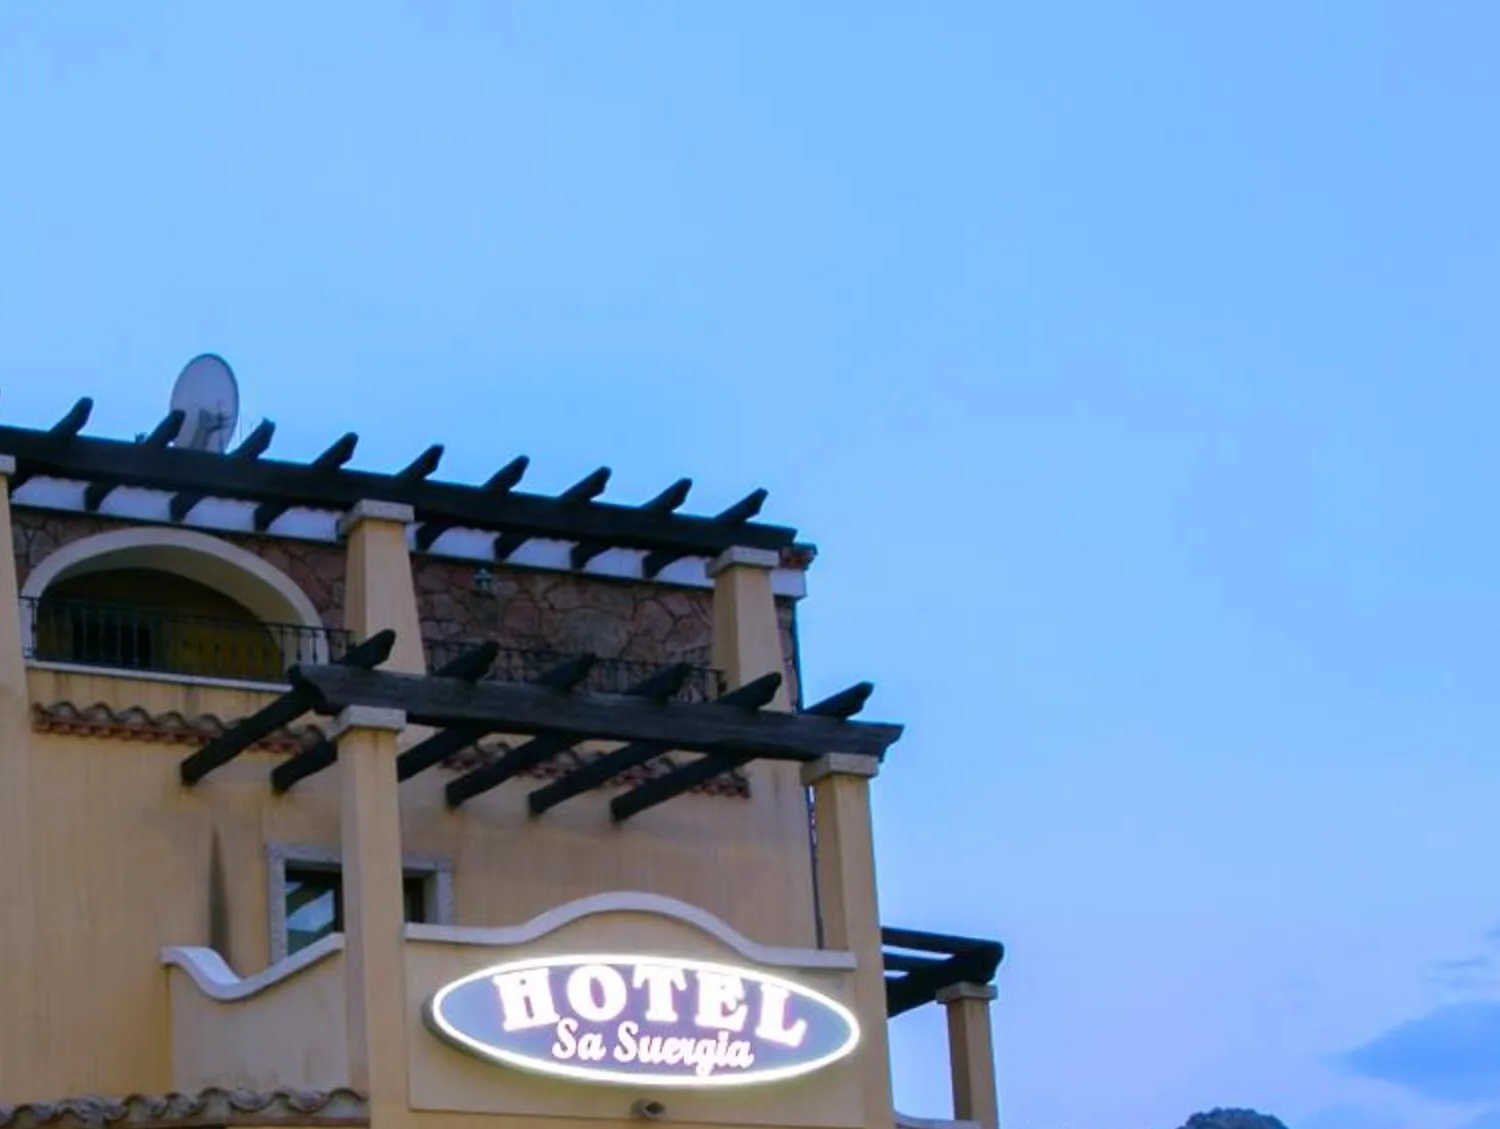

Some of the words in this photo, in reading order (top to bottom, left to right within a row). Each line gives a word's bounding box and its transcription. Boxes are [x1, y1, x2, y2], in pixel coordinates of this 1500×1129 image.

[492, 964, 807, 1047] HOTEL
[552, 1017, 607, 1060] Sa
[613, 1020, 754, 1076] Suergia
